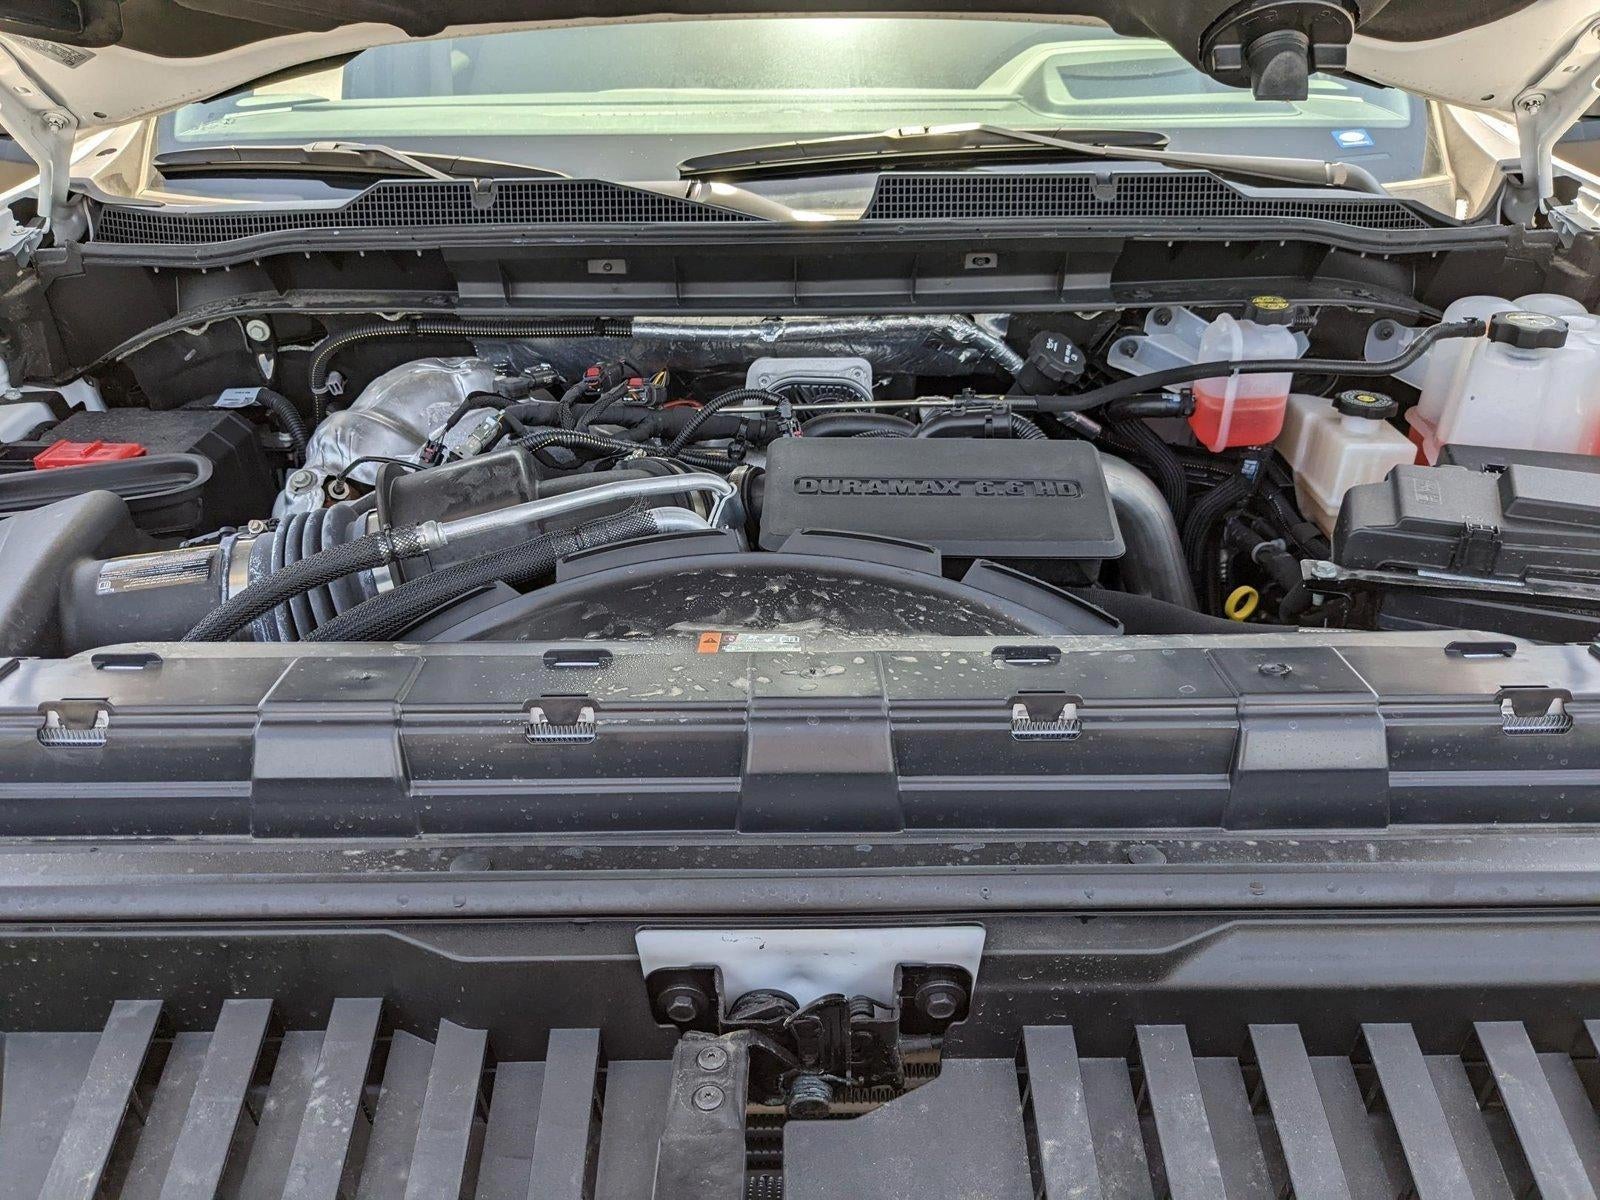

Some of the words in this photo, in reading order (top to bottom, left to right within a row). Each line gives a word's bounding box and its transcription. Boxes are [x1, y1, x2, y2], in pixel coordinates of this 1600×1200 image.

[798, 478, 961, 496] DURAMAX
[974, 480, 1026, 496] 6.6
[1034, 480, 1080, 497] HD
